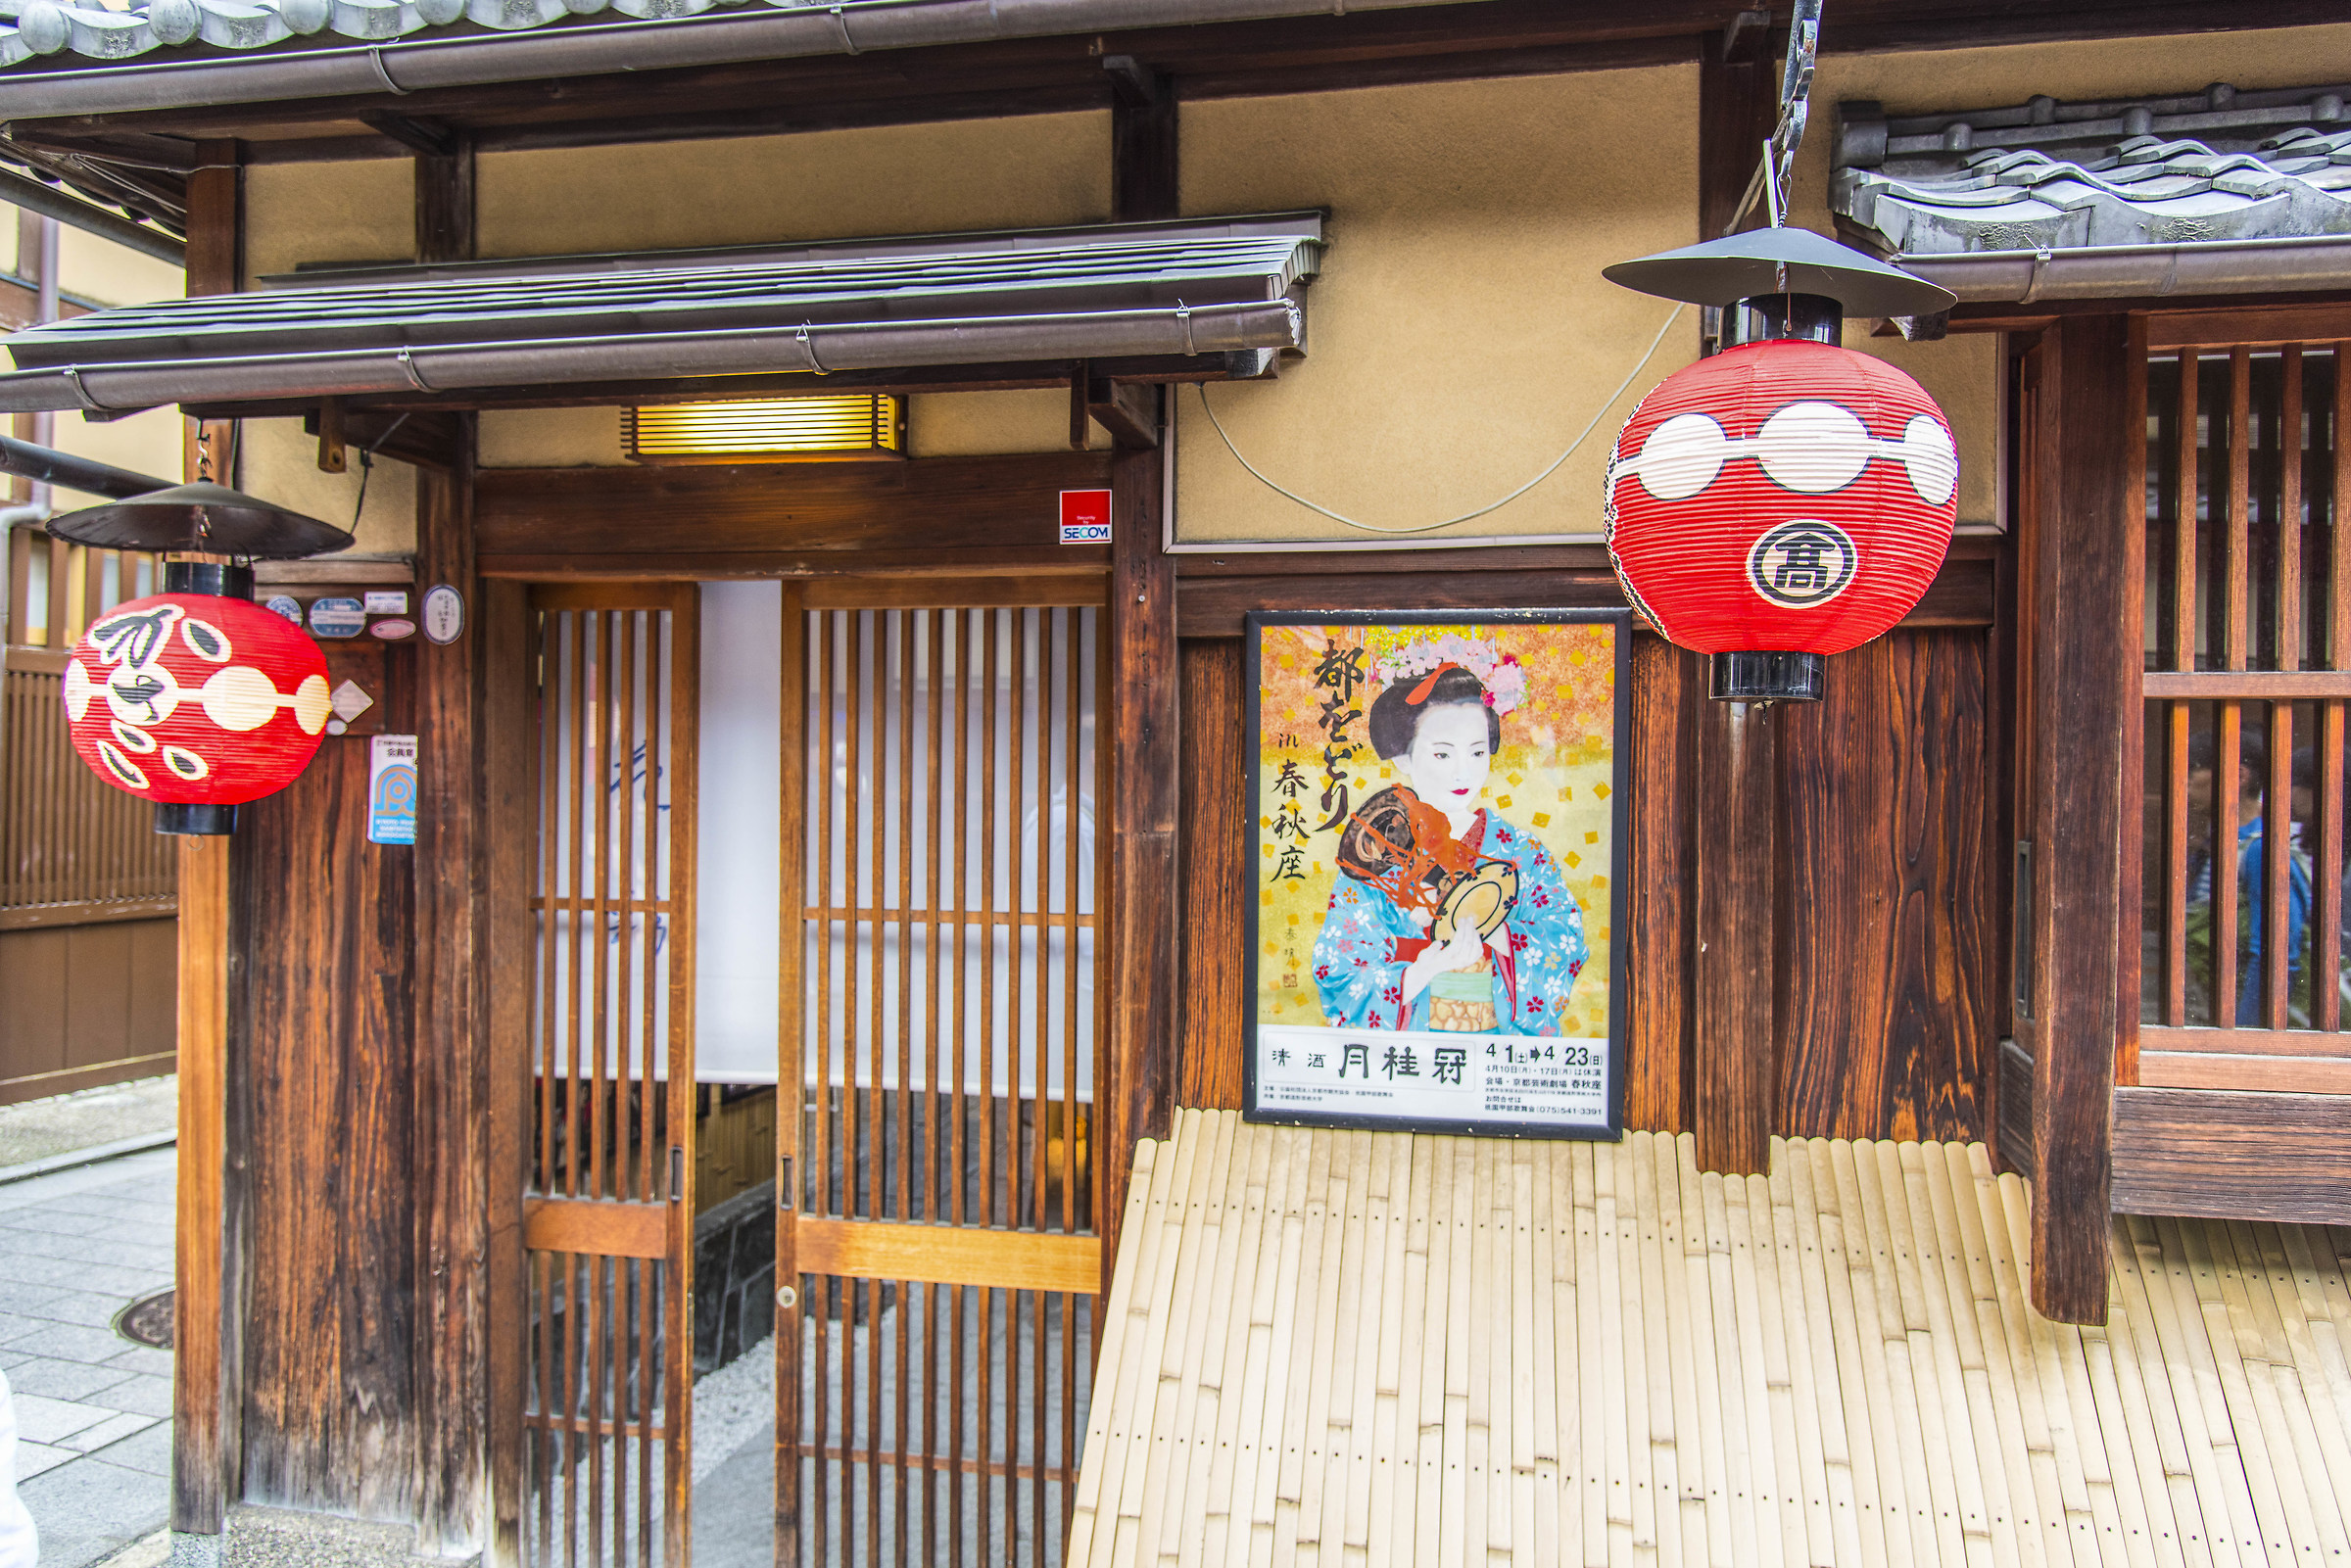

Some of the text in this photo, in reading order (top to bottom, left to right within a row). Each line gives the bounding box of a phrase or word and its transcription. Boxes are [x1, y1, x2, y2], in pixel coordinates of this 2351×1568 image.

[1064, 527, 1108, 539] SECOM
[1278, 732, 1299, 749] in
[1313, 638, 1366, 832] 都をどり
[1271, 758, 1311, 882] 春秋座
[1338, 1043, 1467, 1085] 月桂冠
[1571, 1079, 1602, 1090] 春秋座
